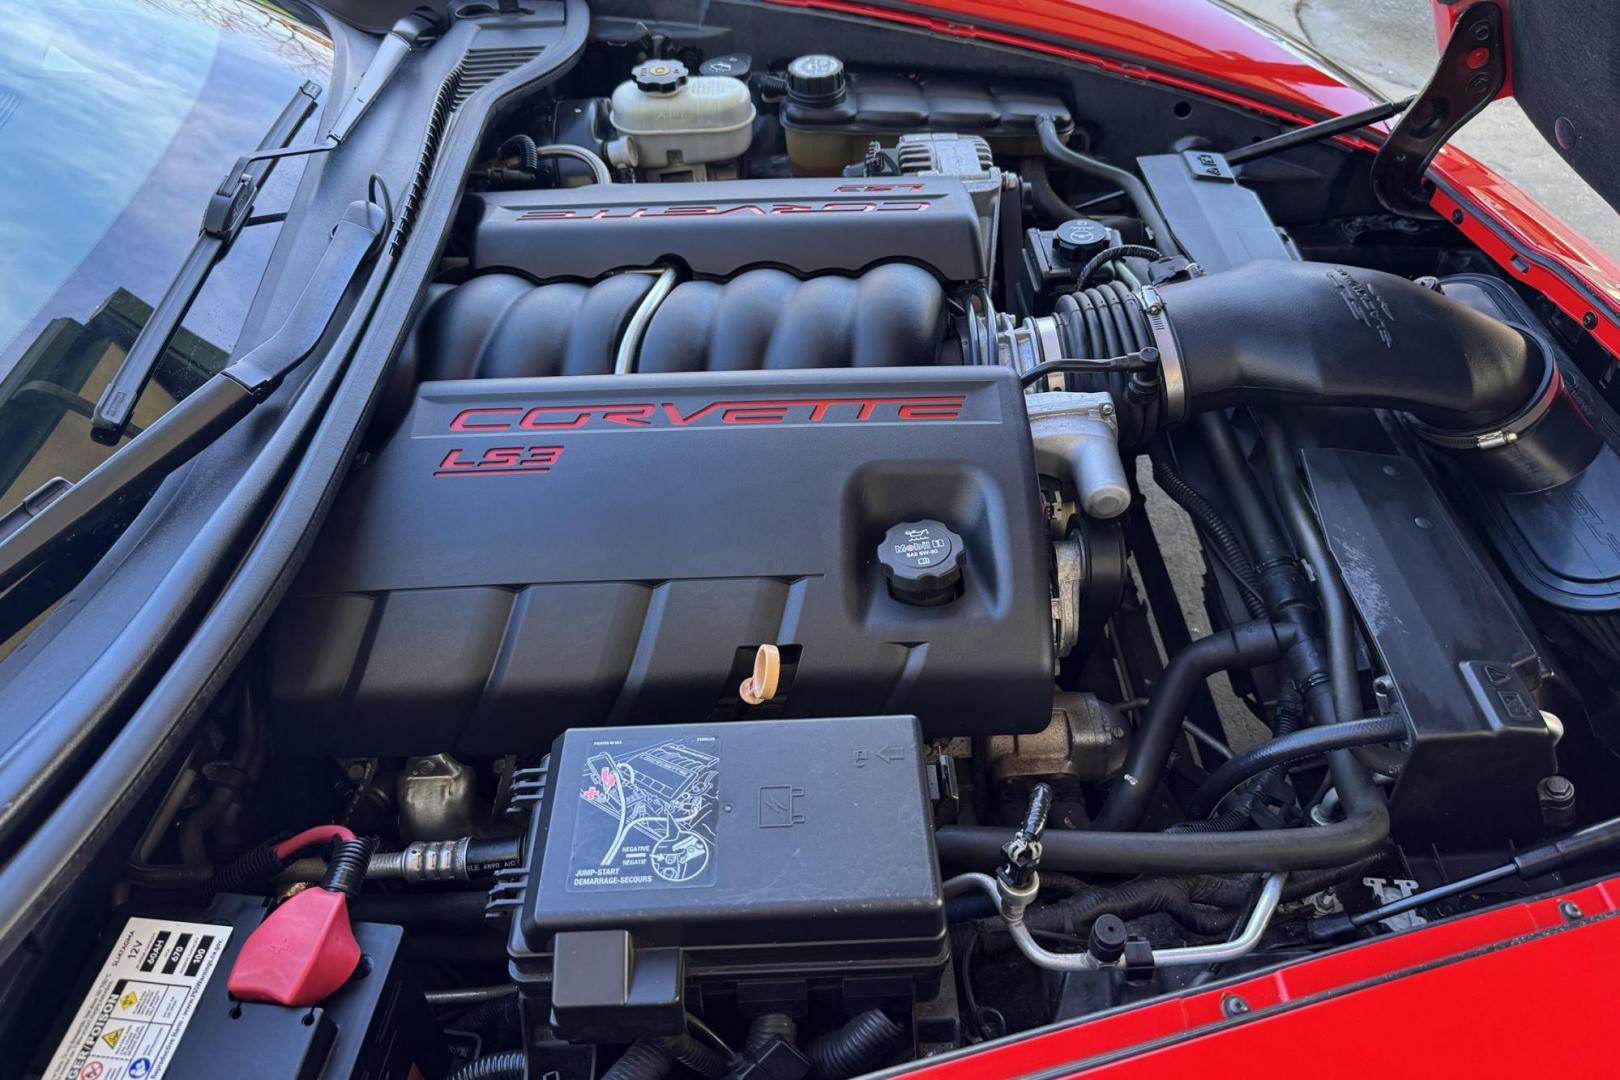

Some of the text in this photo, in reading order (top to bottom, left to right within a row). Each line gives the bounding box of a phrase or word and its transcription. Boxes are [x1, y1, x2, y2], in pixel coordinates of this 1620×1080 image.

[834, 183, 924, 193] LS3
[515, 201, 930, 221] CORVETTE
[449, 395, 967, 432] CORVETTE
[437, 445, 565, 470] LS3
[894, 541, 931, 554] Mobil
[575, 868, 620, 877] JUMP-START
[574, 876, 653, 886] DEMARRAGE-SECOURS
[128, 940, 143, 960] 12V
[147, 940, 165, 965] 60AH
[171, 946, 184, 962] 670
[193, 948, 206, 964] 100
[171, 1020, 184, 1037] Harm
